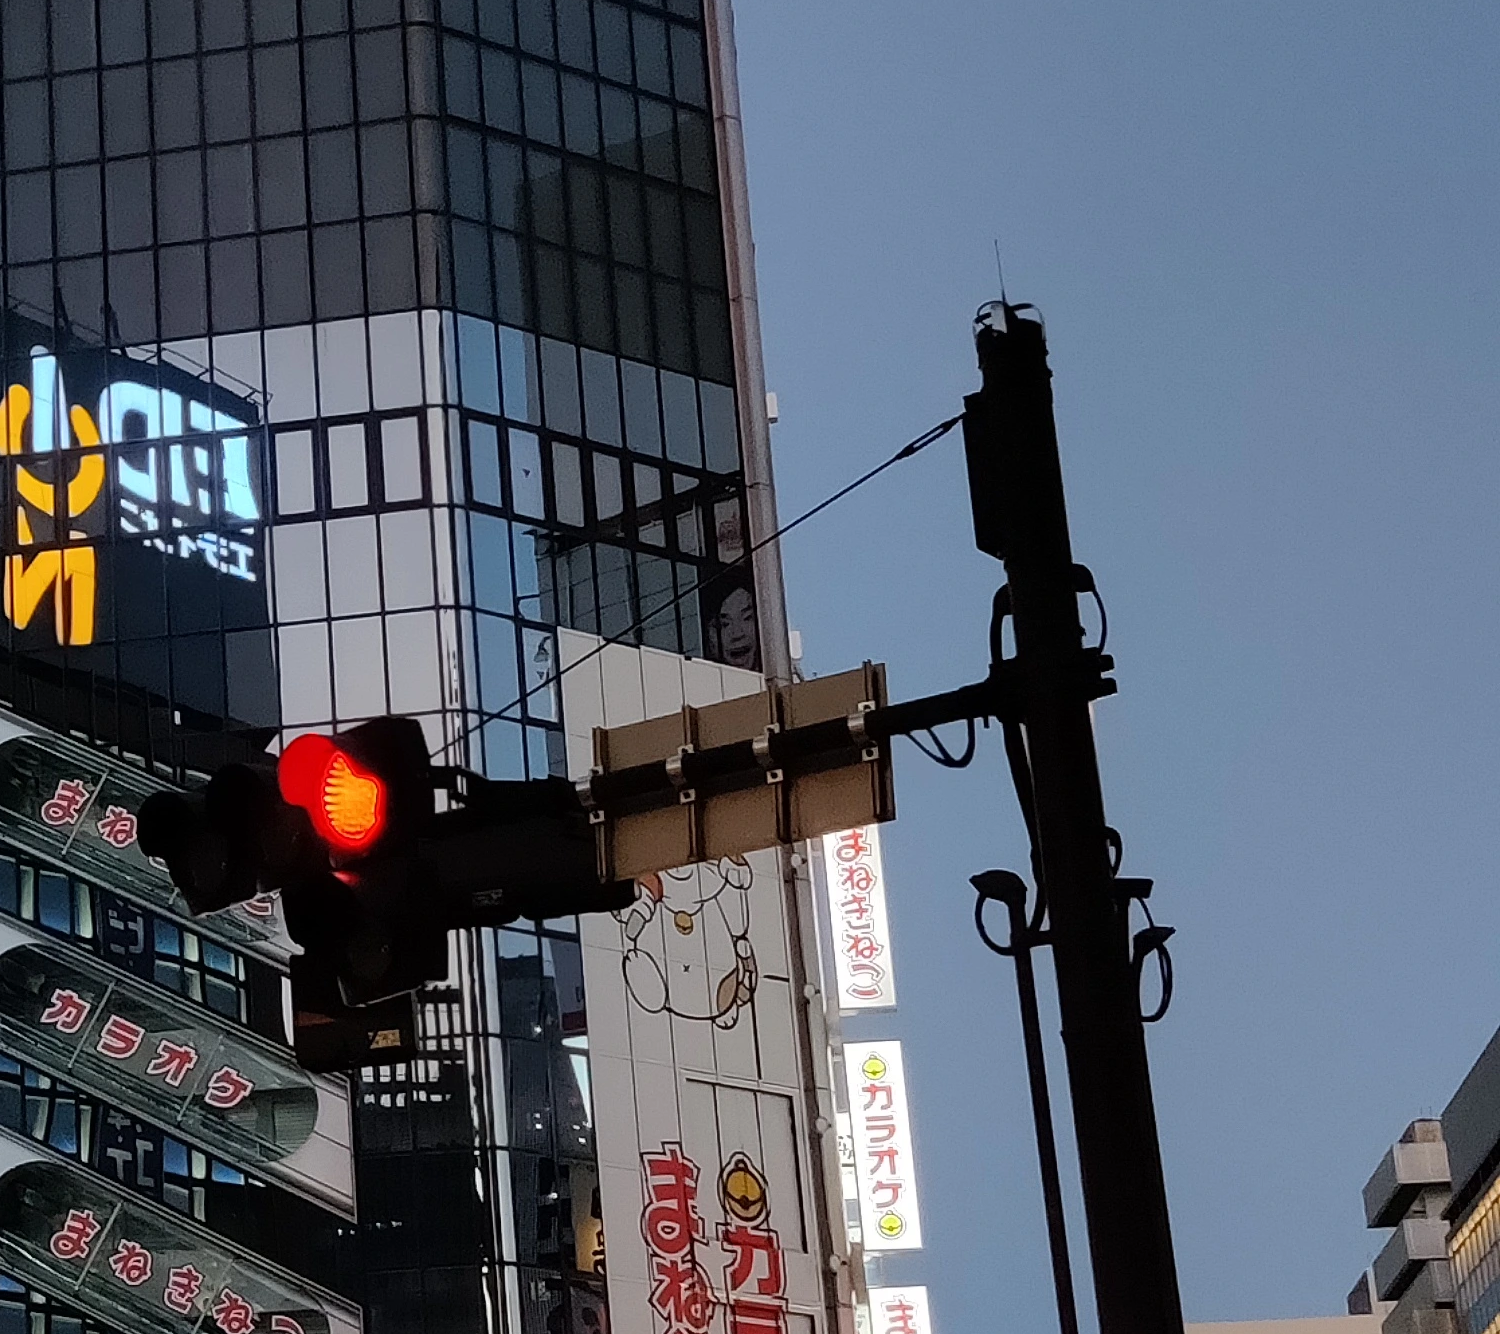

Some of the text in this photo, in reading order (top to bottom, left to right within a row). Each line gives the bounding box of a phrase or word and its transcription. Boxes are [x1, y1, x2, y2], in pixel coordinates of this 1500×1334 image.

[834, 827, 886, 999] まねきねこ
[39, 988, 255, 1110] カラオケ
[860, 1083, 903, 1209] カラオケ
